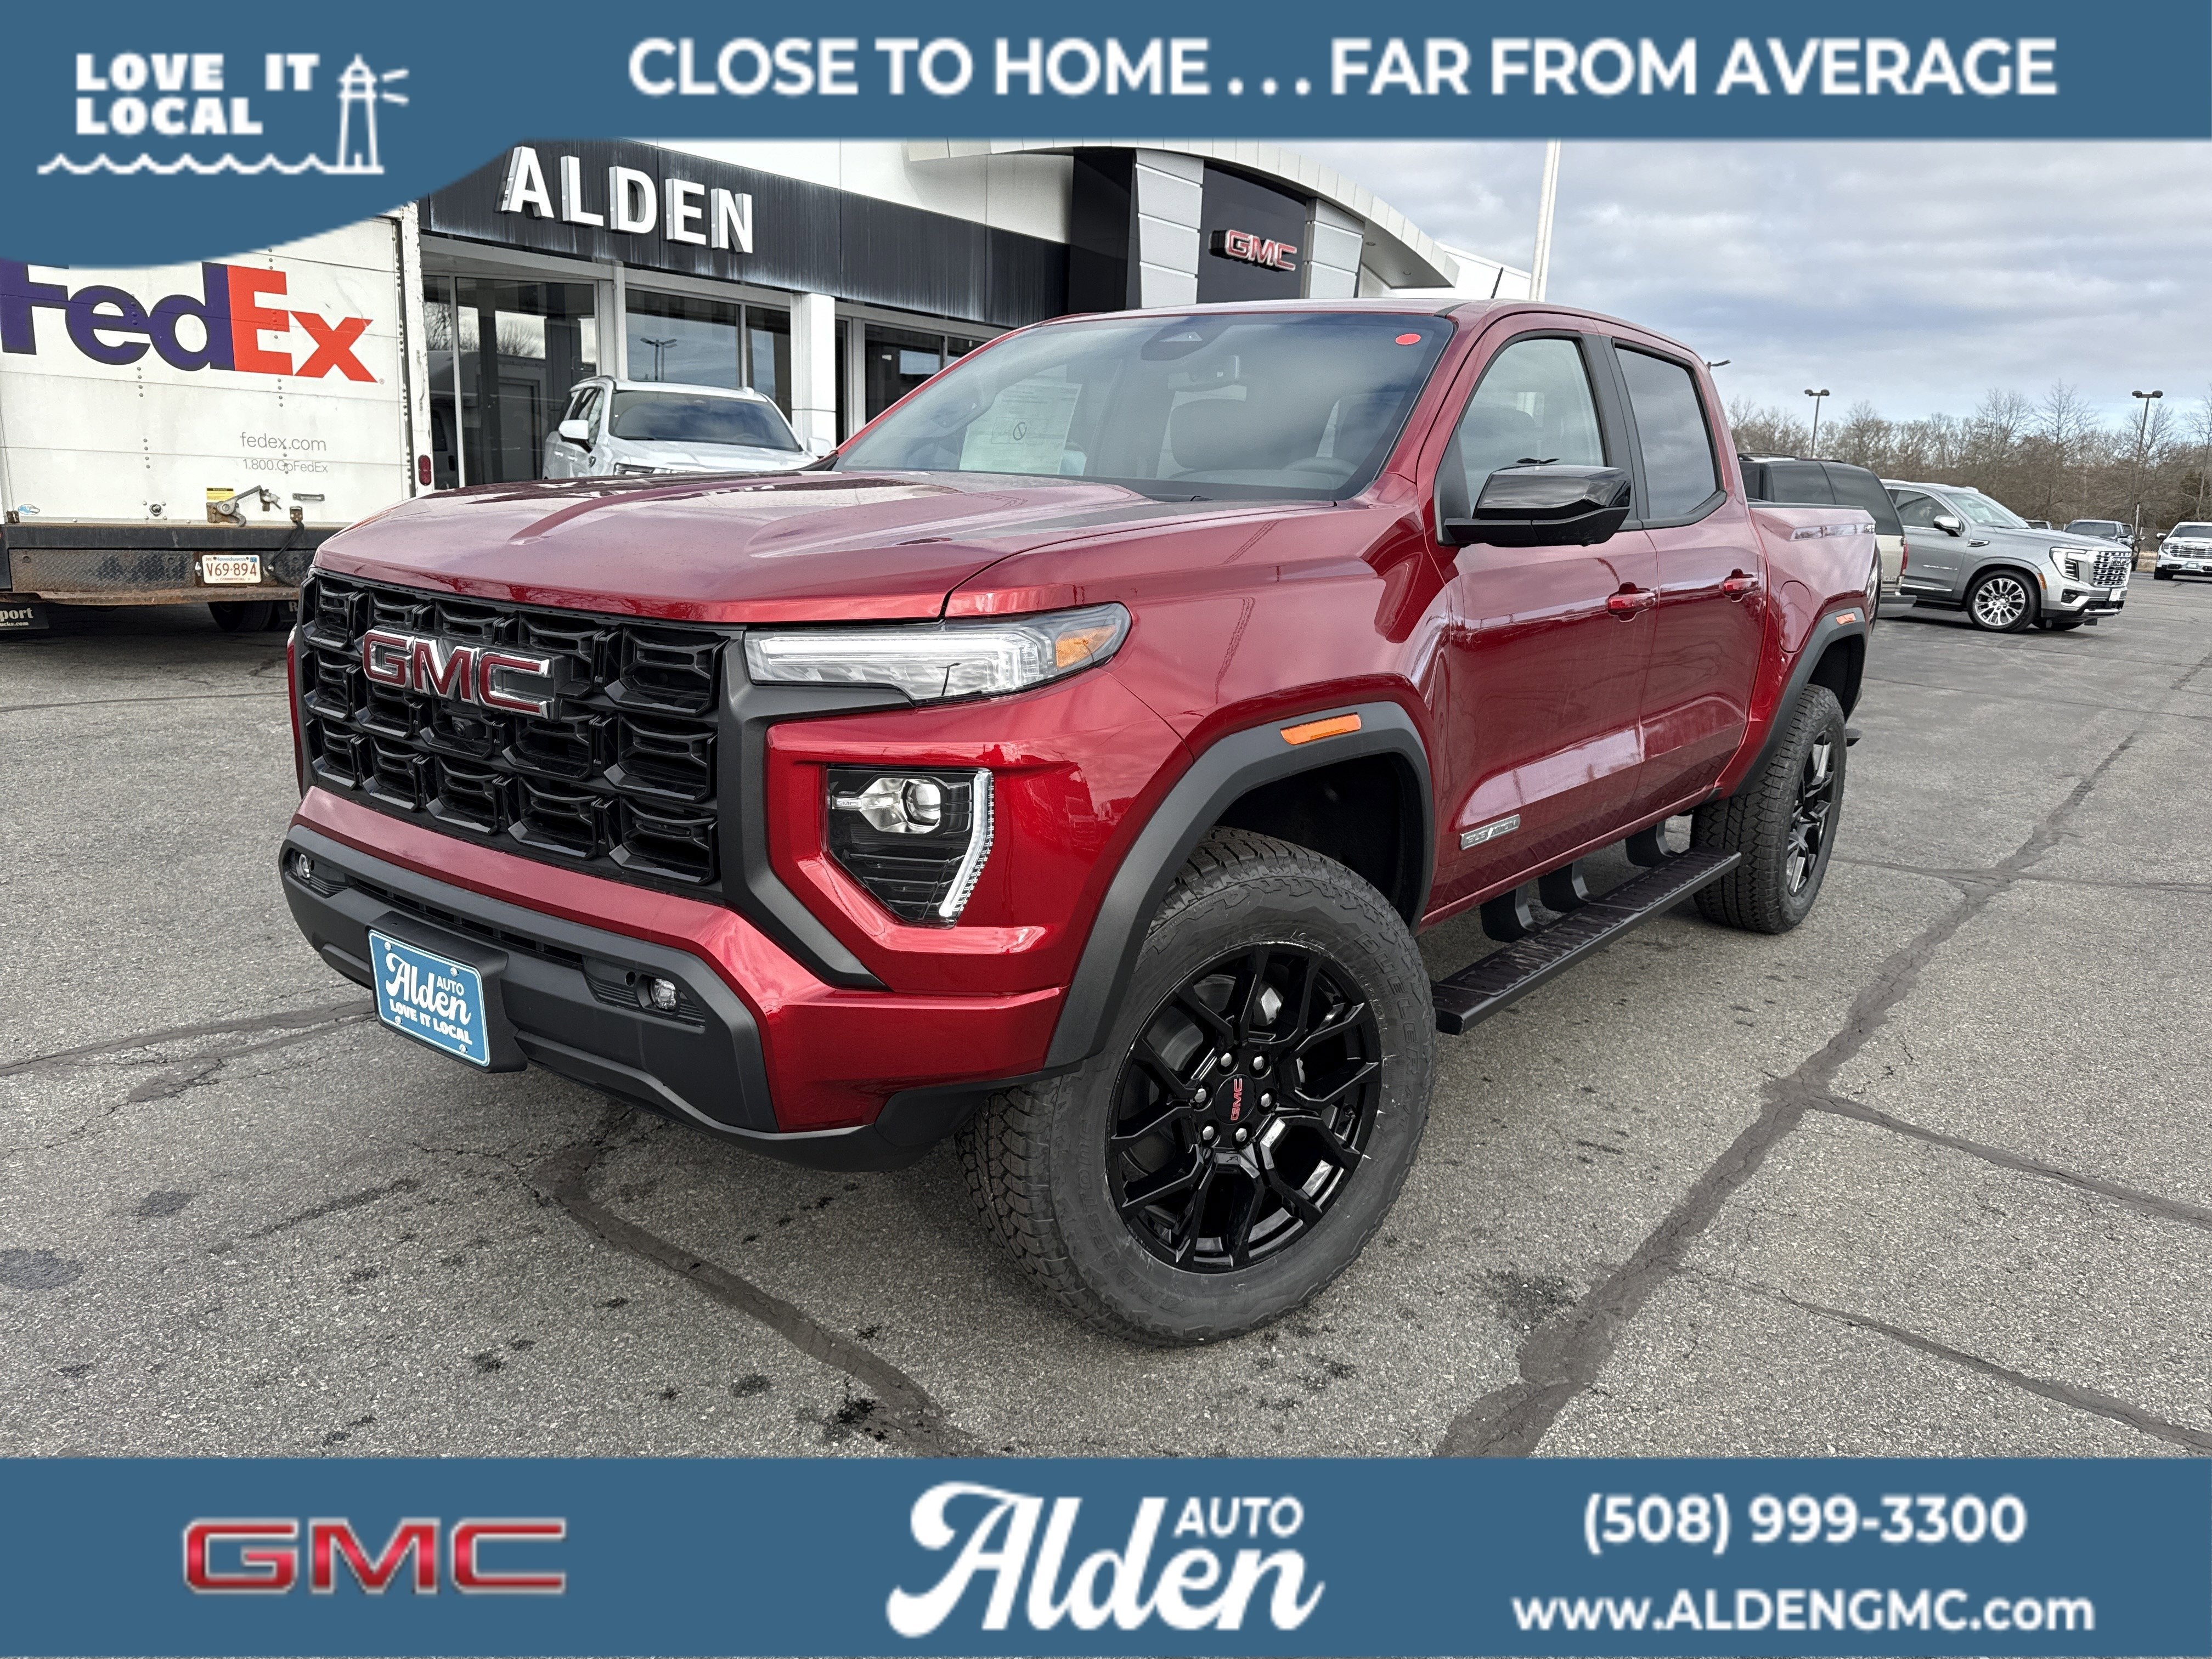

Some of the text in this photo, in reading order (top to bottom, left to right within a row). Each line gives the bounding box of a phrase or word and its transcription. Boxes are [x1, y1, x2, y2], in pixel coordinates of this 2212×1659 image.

[500, 145, 753, 253] ALDEN
[1224, 229, 1298, 272] GMC
[0, 258, 379, 383] FedEx
[240, 431, 327, 452] fedex.com
[242, 459, 329, 473] 1.800.GoFedEx
[362, 629, 549, 719] GMC
[385, 952, 471, 1025] Alden AUTO
[1353, 932, 1420, 1075] DUELER
[389, 998, 473, 1045] LOVE IT LOCAL
[1231, 1078, 1243, 1121] GMC
